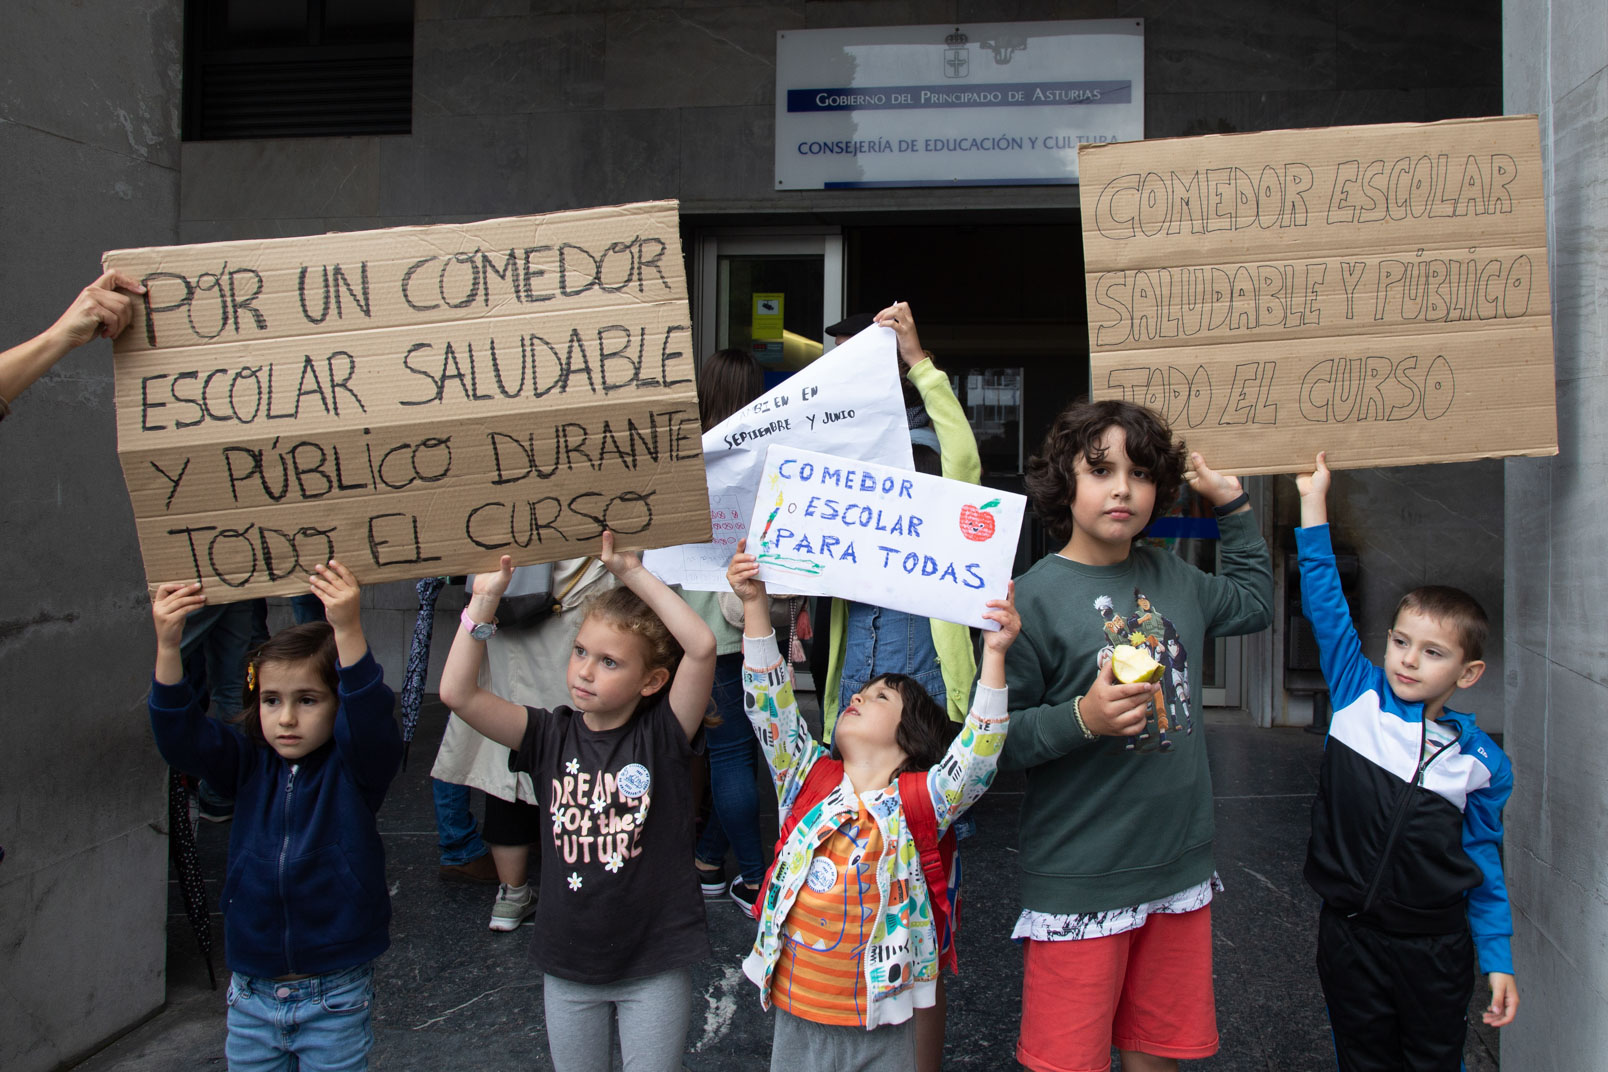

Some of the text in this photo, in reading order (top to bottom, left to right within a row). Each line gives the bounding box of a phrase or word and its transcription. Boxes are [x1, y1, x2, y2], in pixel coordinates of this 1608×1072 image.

[891, 93, 913, 104] DEL
[1008, 91, 1025, 102] DE
[797, 136, 891, 157] CONSEJERÍA
[898, 139, 919, 153] DE
[924, 134, 1019, 152] EDUCACIÓN
[1029, 136, 1038, 150] Y
[1095, 154, 1517, 240] COMEDOR ESCOLAR
[141, 235, 672, 347] POR UN COMEDOR
[1095, 263, 1327, 346] SALUDABLE
[1340, 261, 1366, 319] Y
[141, 325, 692, 432] ESCOLAR SALUDABLE
[1108, 354, 1455, 428] TODO EL CURSO
[806, 414, 816, 430] Y
[822, 409, 855, 424] JUNIO
[150, 457, 190, 511] Y
[487, 410, 702, 485] DURANTE
[779, 459, 914, 499] COMEDOR
[167, 489, 656, 587] TODO EL CURSO
[804, 496, 924, 538] ESCOLAR
[770, 528, 985, 589] PARA TODAS
[597, 808, 635, 834] the
